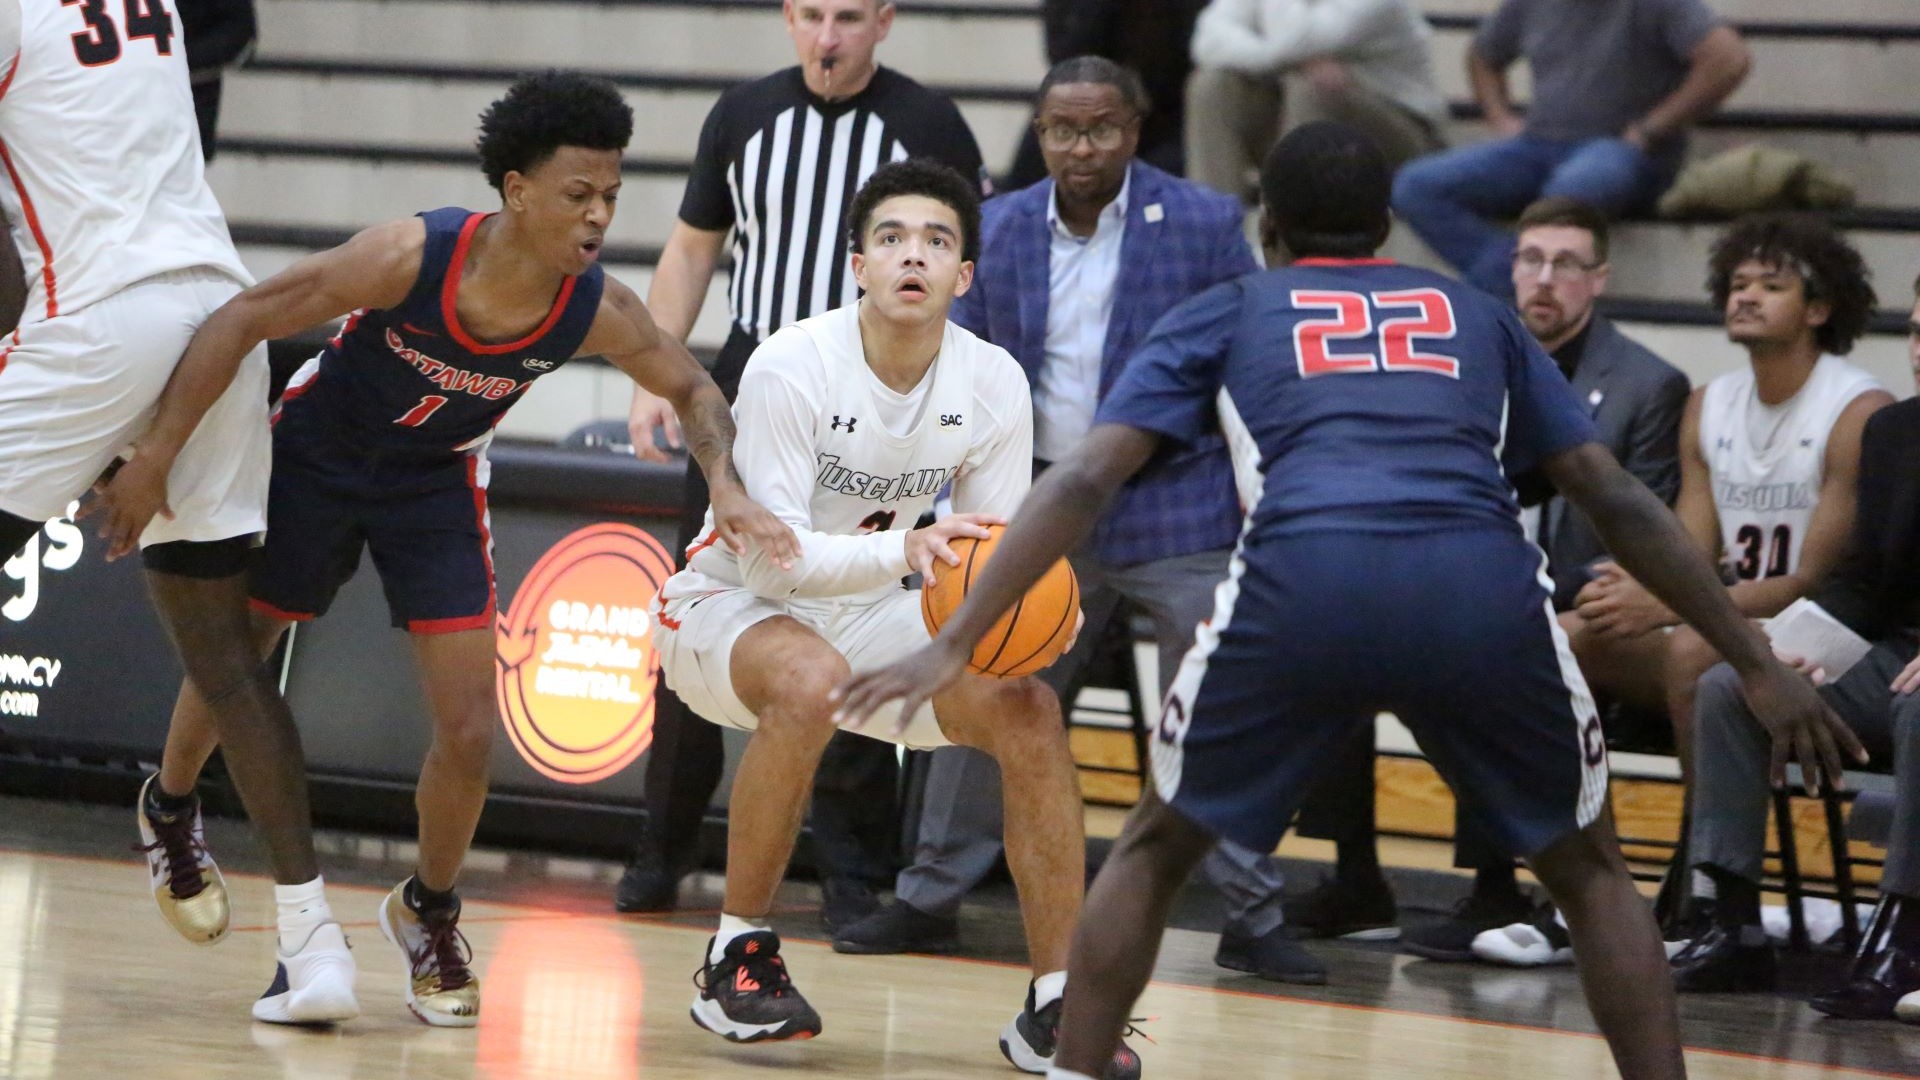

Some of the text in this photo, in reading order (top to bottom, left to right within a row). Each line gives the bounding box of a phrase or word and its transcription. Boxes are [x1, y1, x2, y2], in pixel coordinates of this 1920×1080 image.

[60, 0, 175, 67] 34
[1290, 287, 1460, 380] 22
[523, 358, 554, 371] SAC
[392, 395, 449, 427] 1
[940, 414, 963, 426] SAC
[1735, 524, 1791, 579] 30
[549, 600, 650, 637] GRAND
[0, 653, 61, 688] MACY
[1160, 693, 1185, 745] C
